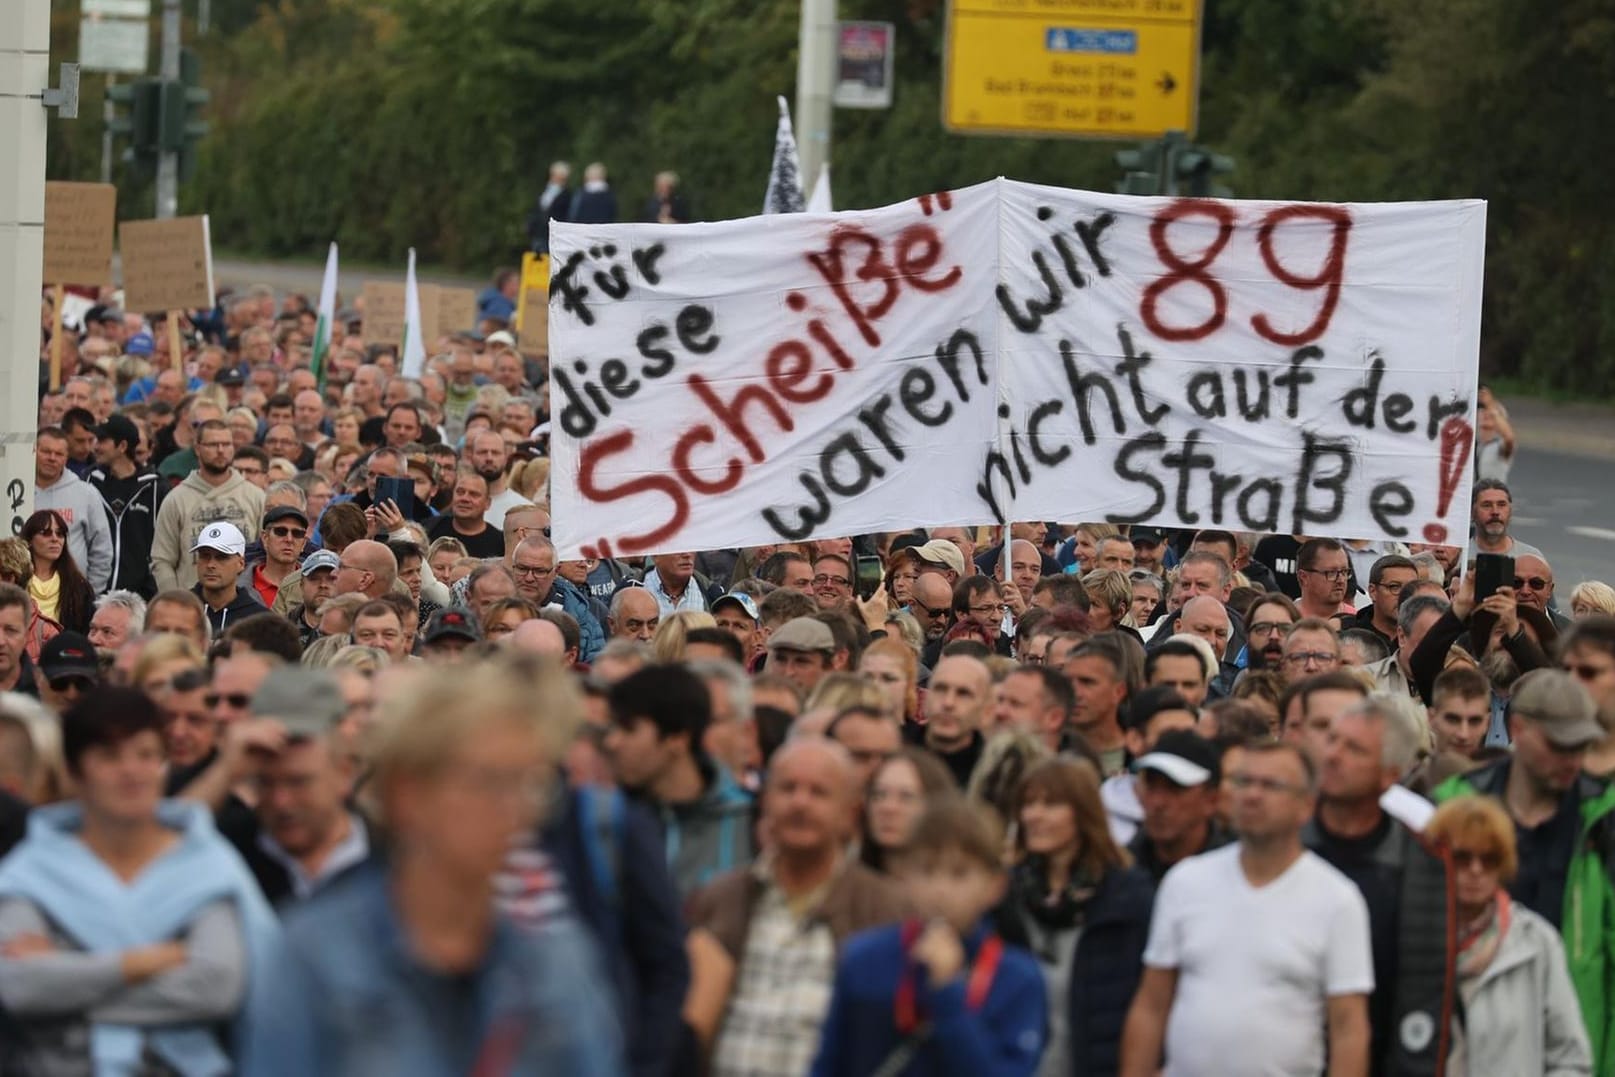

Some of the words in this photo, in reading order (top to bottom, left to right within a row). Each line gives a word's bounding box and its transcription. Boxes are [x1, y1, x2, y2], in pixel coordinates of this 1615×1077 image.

[553, 305, 719, 438] diese
[762, 328, 989, 540] waren
[995, 206, 1117, 333] wir
[1140, 197, 1353, 346] 89
[977, 322, 1171, 524] nicht
[1187, 346, 1324, 421] auf
[1343, 355, 1468, 440] der
